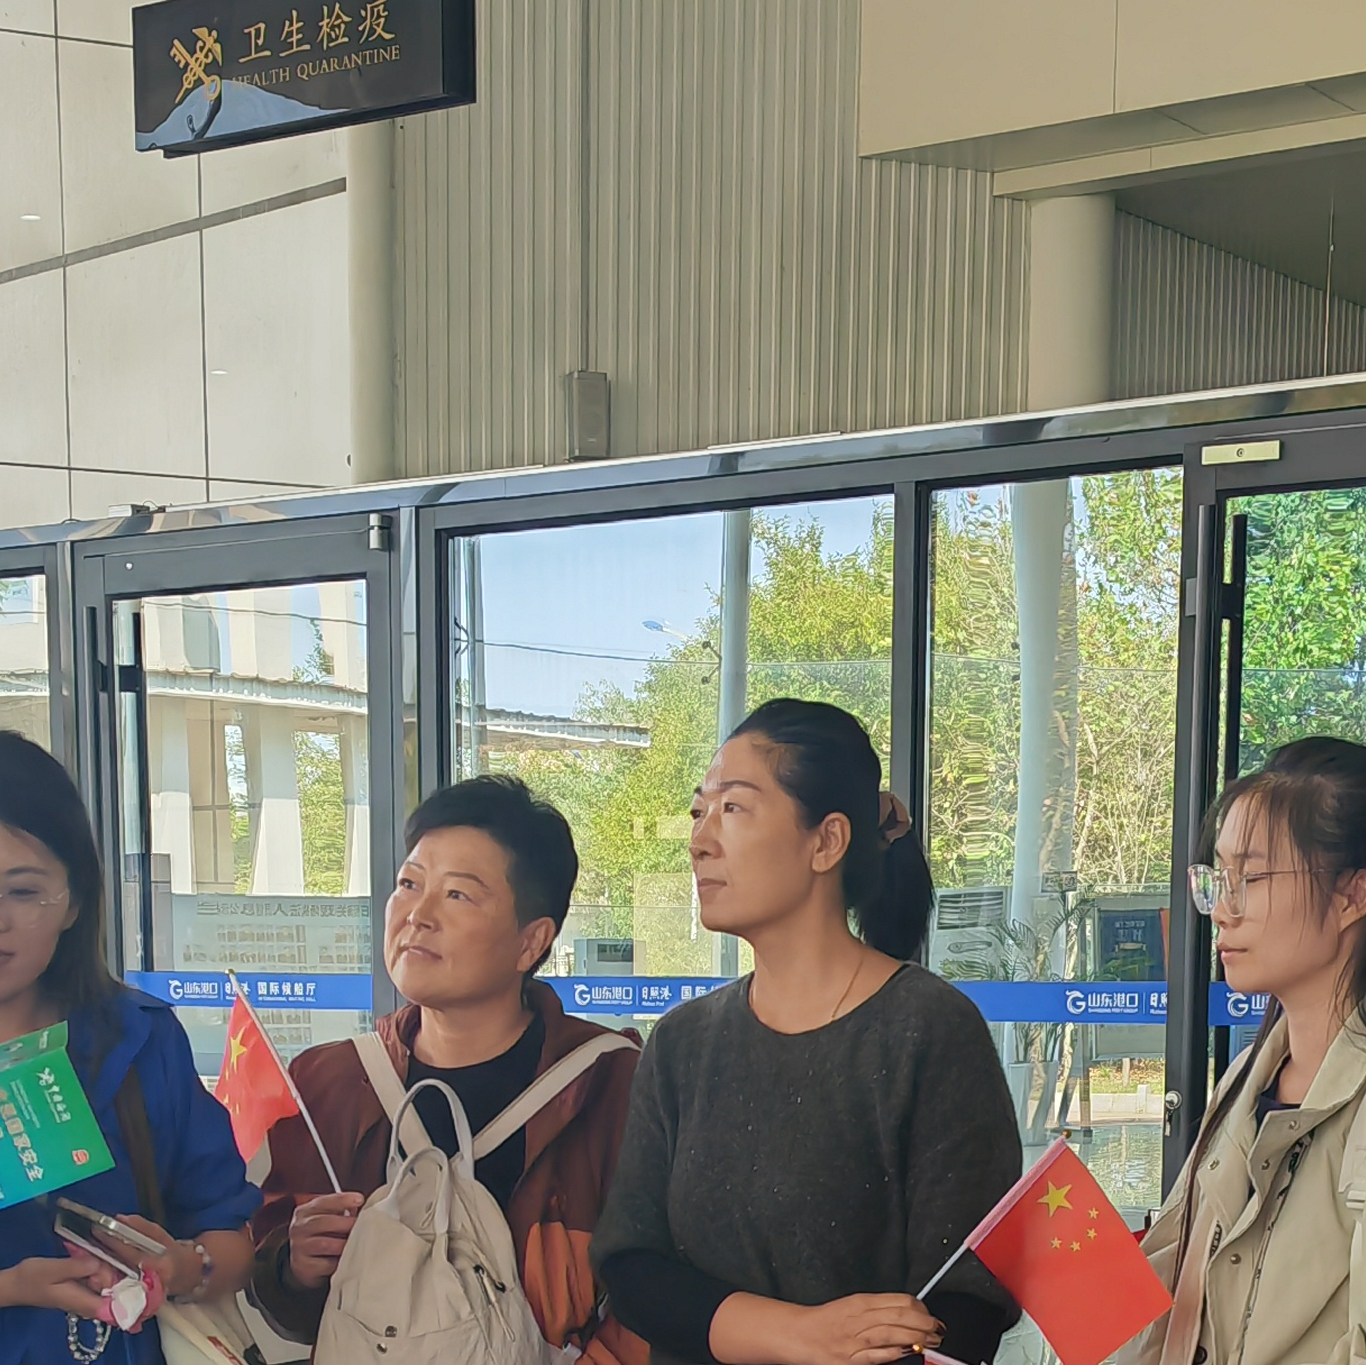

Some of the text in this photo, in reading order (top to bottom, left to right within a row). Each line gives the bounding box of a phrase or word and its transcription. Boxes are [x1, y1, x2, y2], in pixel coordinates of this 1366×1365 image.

[237, 0, 396, 63] 卫生检疫
[296, 44, 401, 81] QUARANTINE
[257, 982, 317, 997] 国际候船厅
[680, 985, 720, 1000] 国际
[1087, 992, 1139, 1008] 山东港口
